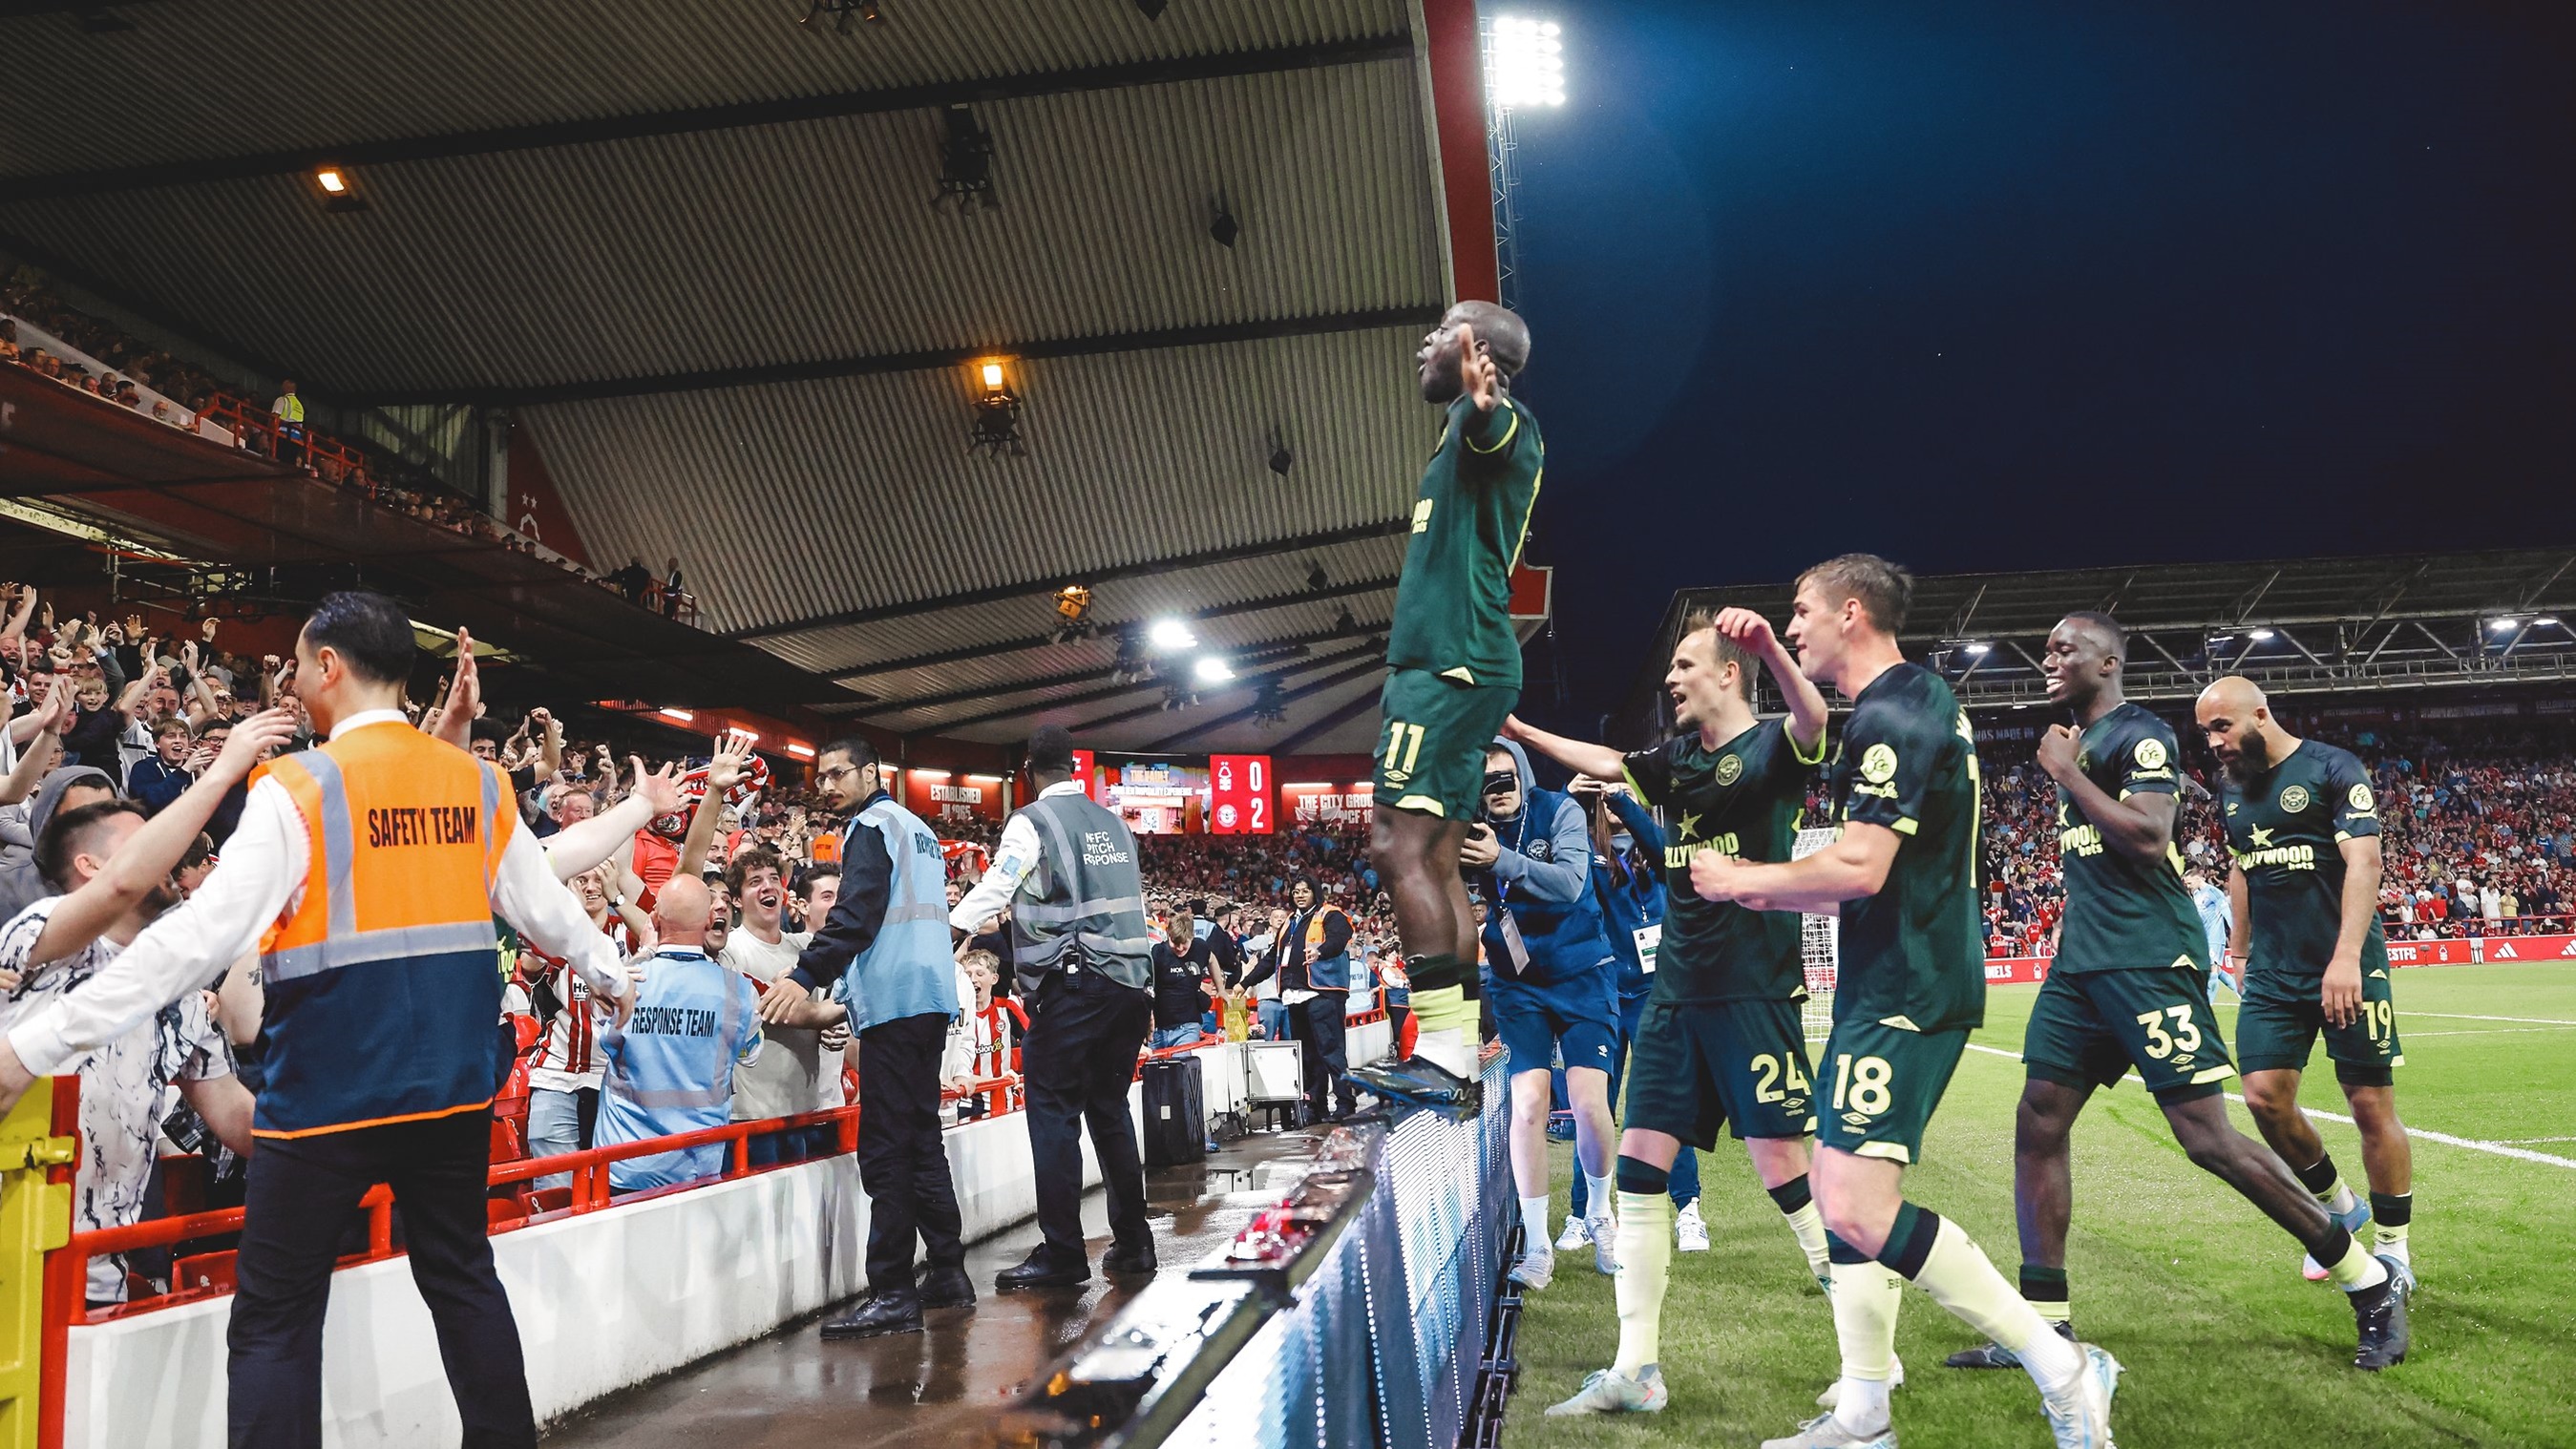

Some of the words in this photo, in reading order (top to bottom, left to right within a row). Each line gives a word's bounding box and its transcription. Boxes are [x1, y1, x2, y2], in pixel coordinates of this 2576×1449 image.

[1383, 721, 1425, 774] 11
[1249, 761, 1262, 792] 0
[930, 784, 982, 804] ESTABLISHED
[1298, 794, 1319, 808] THE
[1320, 794, 1344, 809] CITY
[369, 808, 428, 849] SAFETY
[430, 806, 475, 845] TEAM
[1250, 797, 1264, 829] 2
[1083, 851, 1130, 866] RSPONSE
[1087, 842, 1115, 854] PITCH
[2078, 843, 2103, 857] bets
[631, 1007, 684, 1036] RESPONSE
[686, 1009, 716, 1038] TEAM
[2136, 1003, 2202, 1060] 33
[2362, 999, 2392, 1040] 19
[1750, 1051, 1812, 1103] 24
[1832, 1053, 1893, 1116] 18
